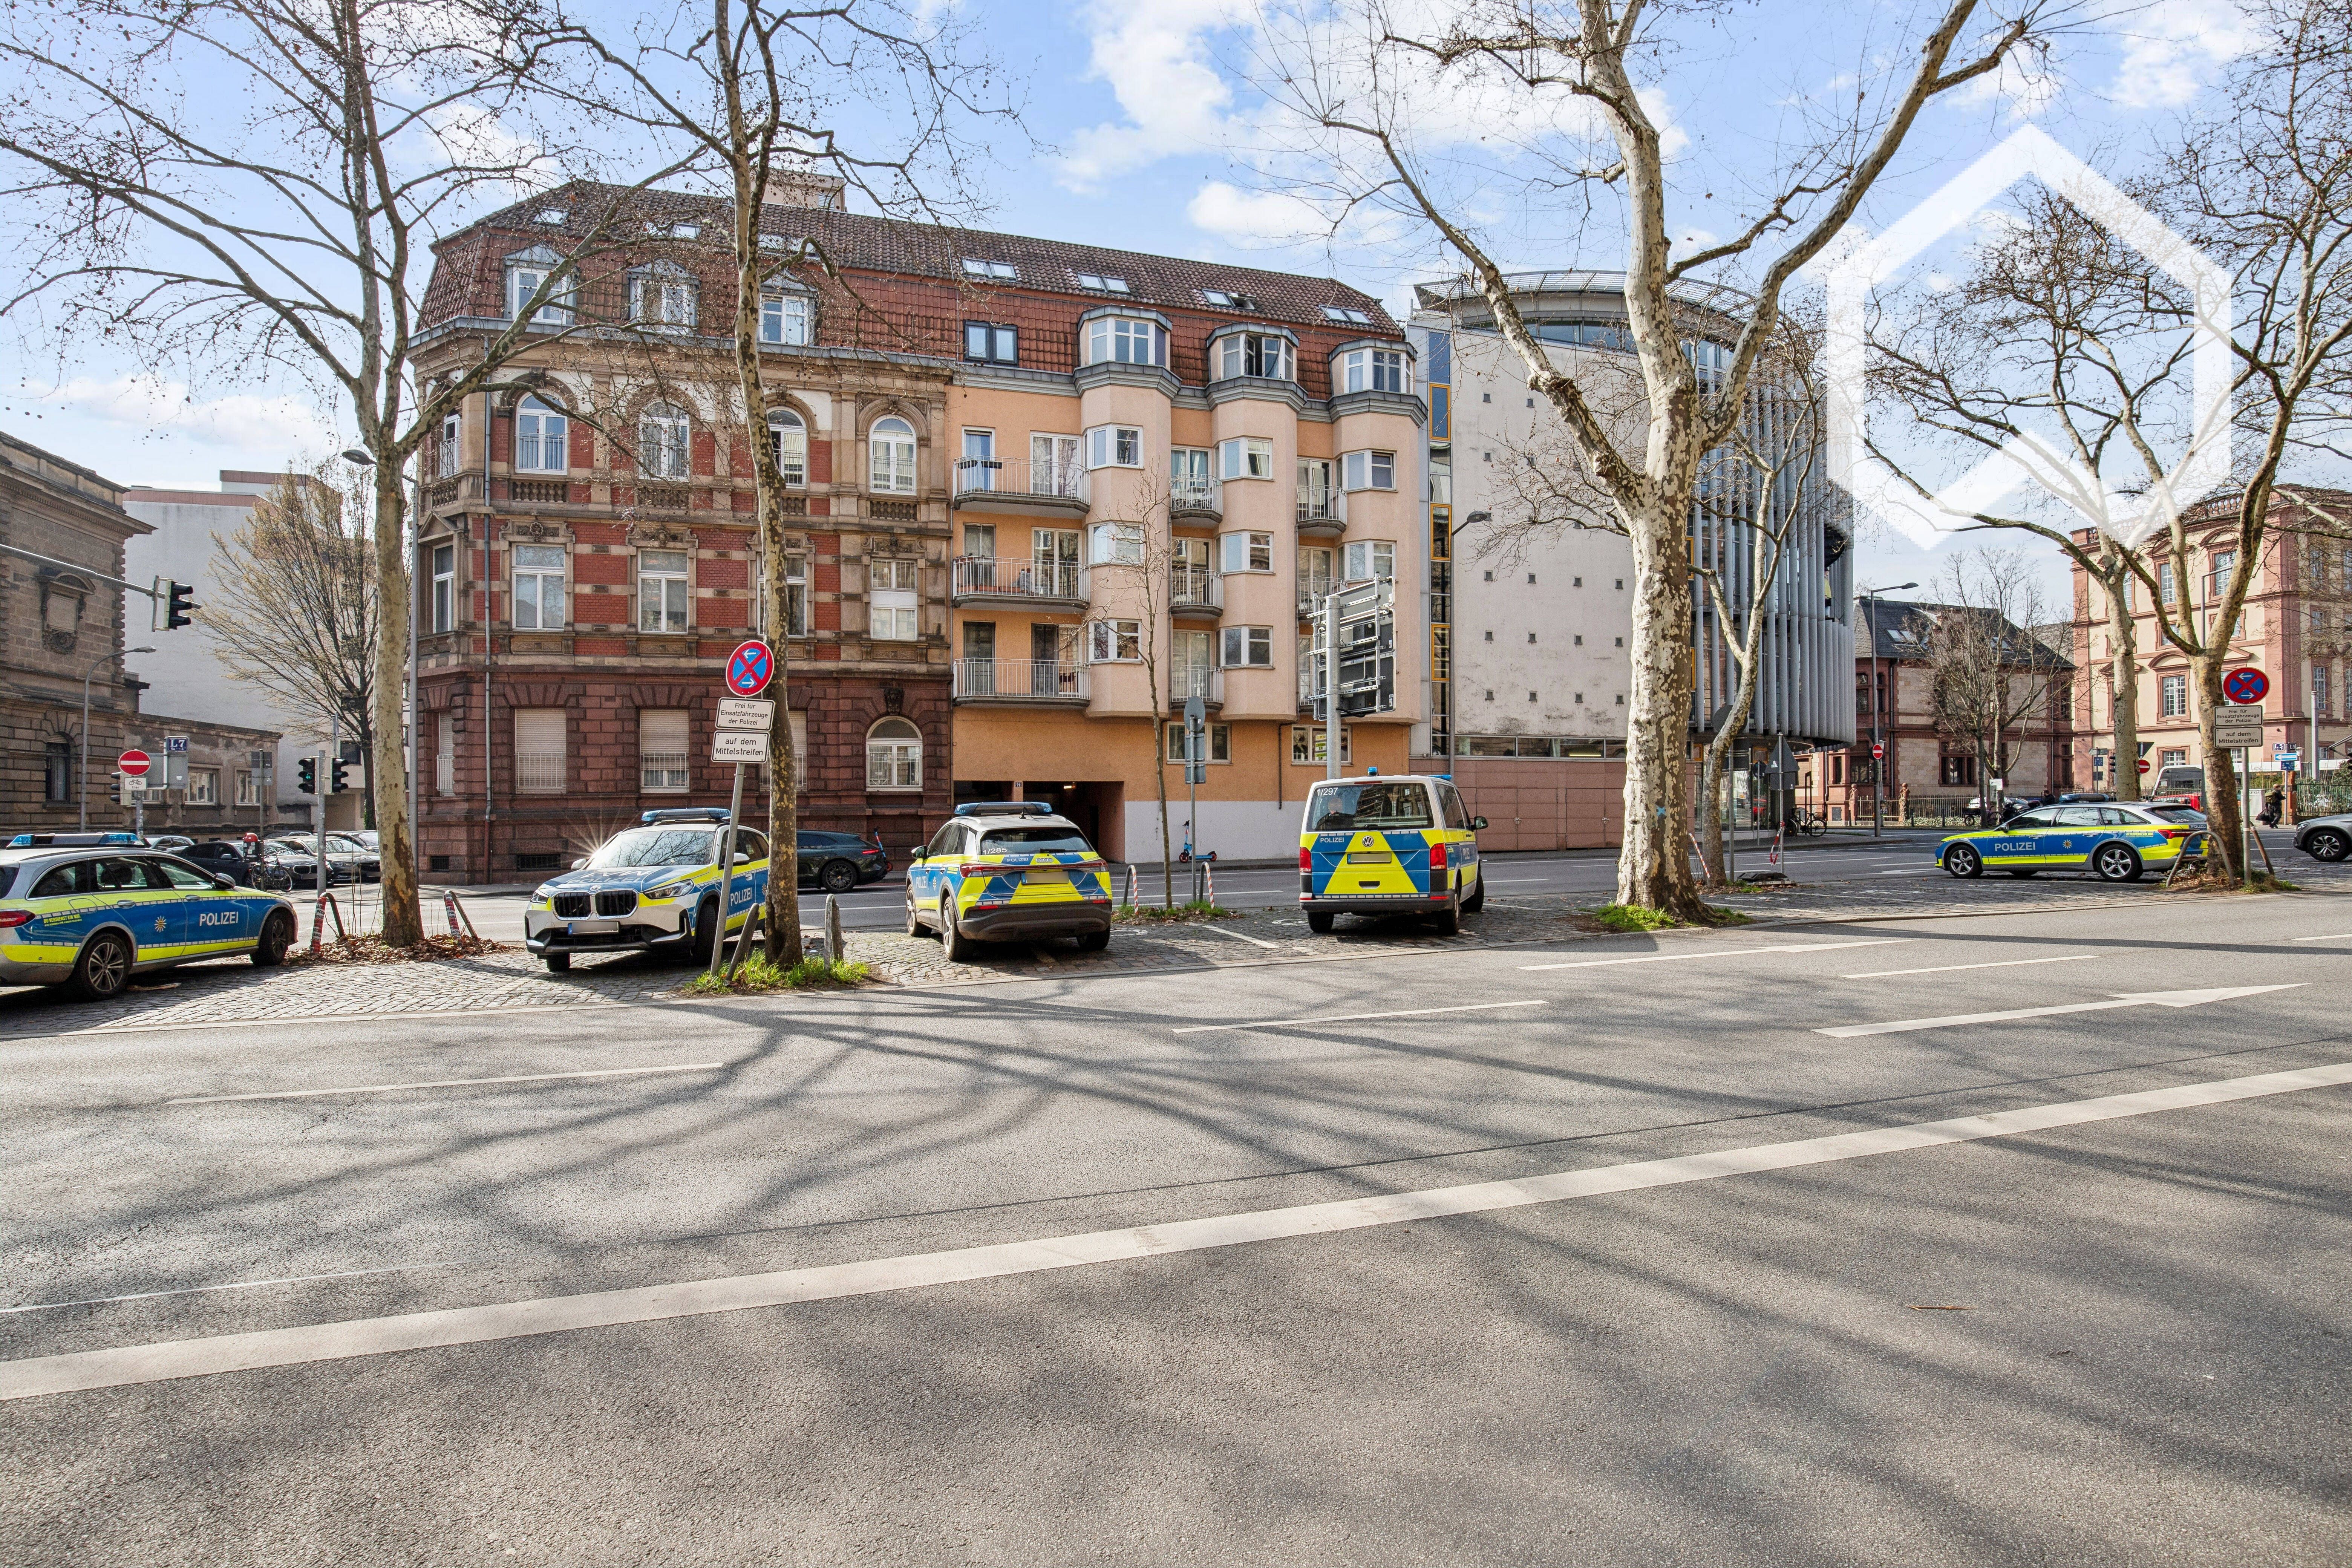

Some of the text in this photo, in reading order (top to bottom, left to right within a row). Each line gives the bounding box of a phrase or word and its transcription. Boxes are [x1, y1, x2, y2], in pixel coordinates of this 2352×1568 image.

[720, 710, 768, 719] Einsatzfahrzeuge
[715, 747, 763, 756] Mittelstreifen
[1317, 787, 1338, 796] 1/297
[1995, 842, 2036, 851] POLIZEI
[916, 876, 927, 888] POLIZEI
[730, 887, 752, 906] POLIZEI
[199, 911, 239, 926] POLIZEI
